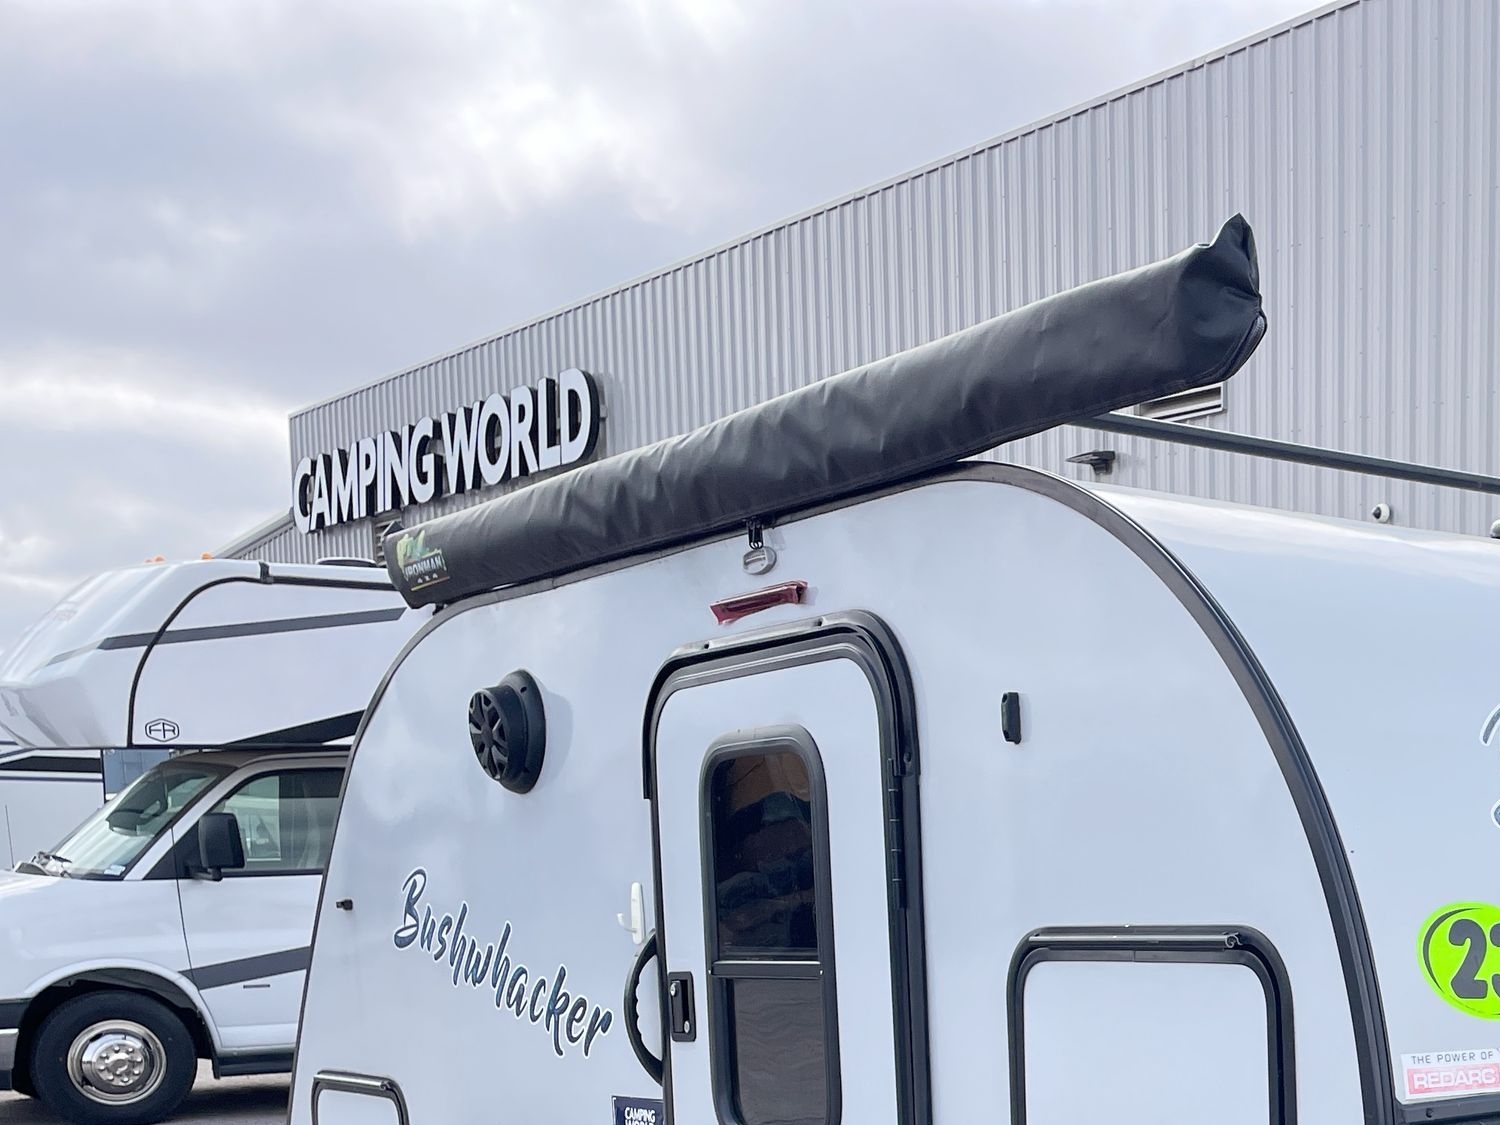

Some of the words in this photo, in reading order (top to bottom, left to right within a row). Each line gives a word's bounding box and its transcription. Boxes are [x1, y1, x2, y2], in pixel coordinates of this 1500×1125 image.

[293, 416, 438, 534] CAMPING
[441, 368, 595, 495] WORLD
[394, 868, 613, 1058] Bushwhacker
[1411, 1055, 1432, 1065] THE
[1437, 1052, 1476, 1063] POWER
[1480, 1050, 1494, 1061] OF
[1412, 1067, 1497, 1091] REDARC
[624, 1107, 656, 1123] CAMPING
